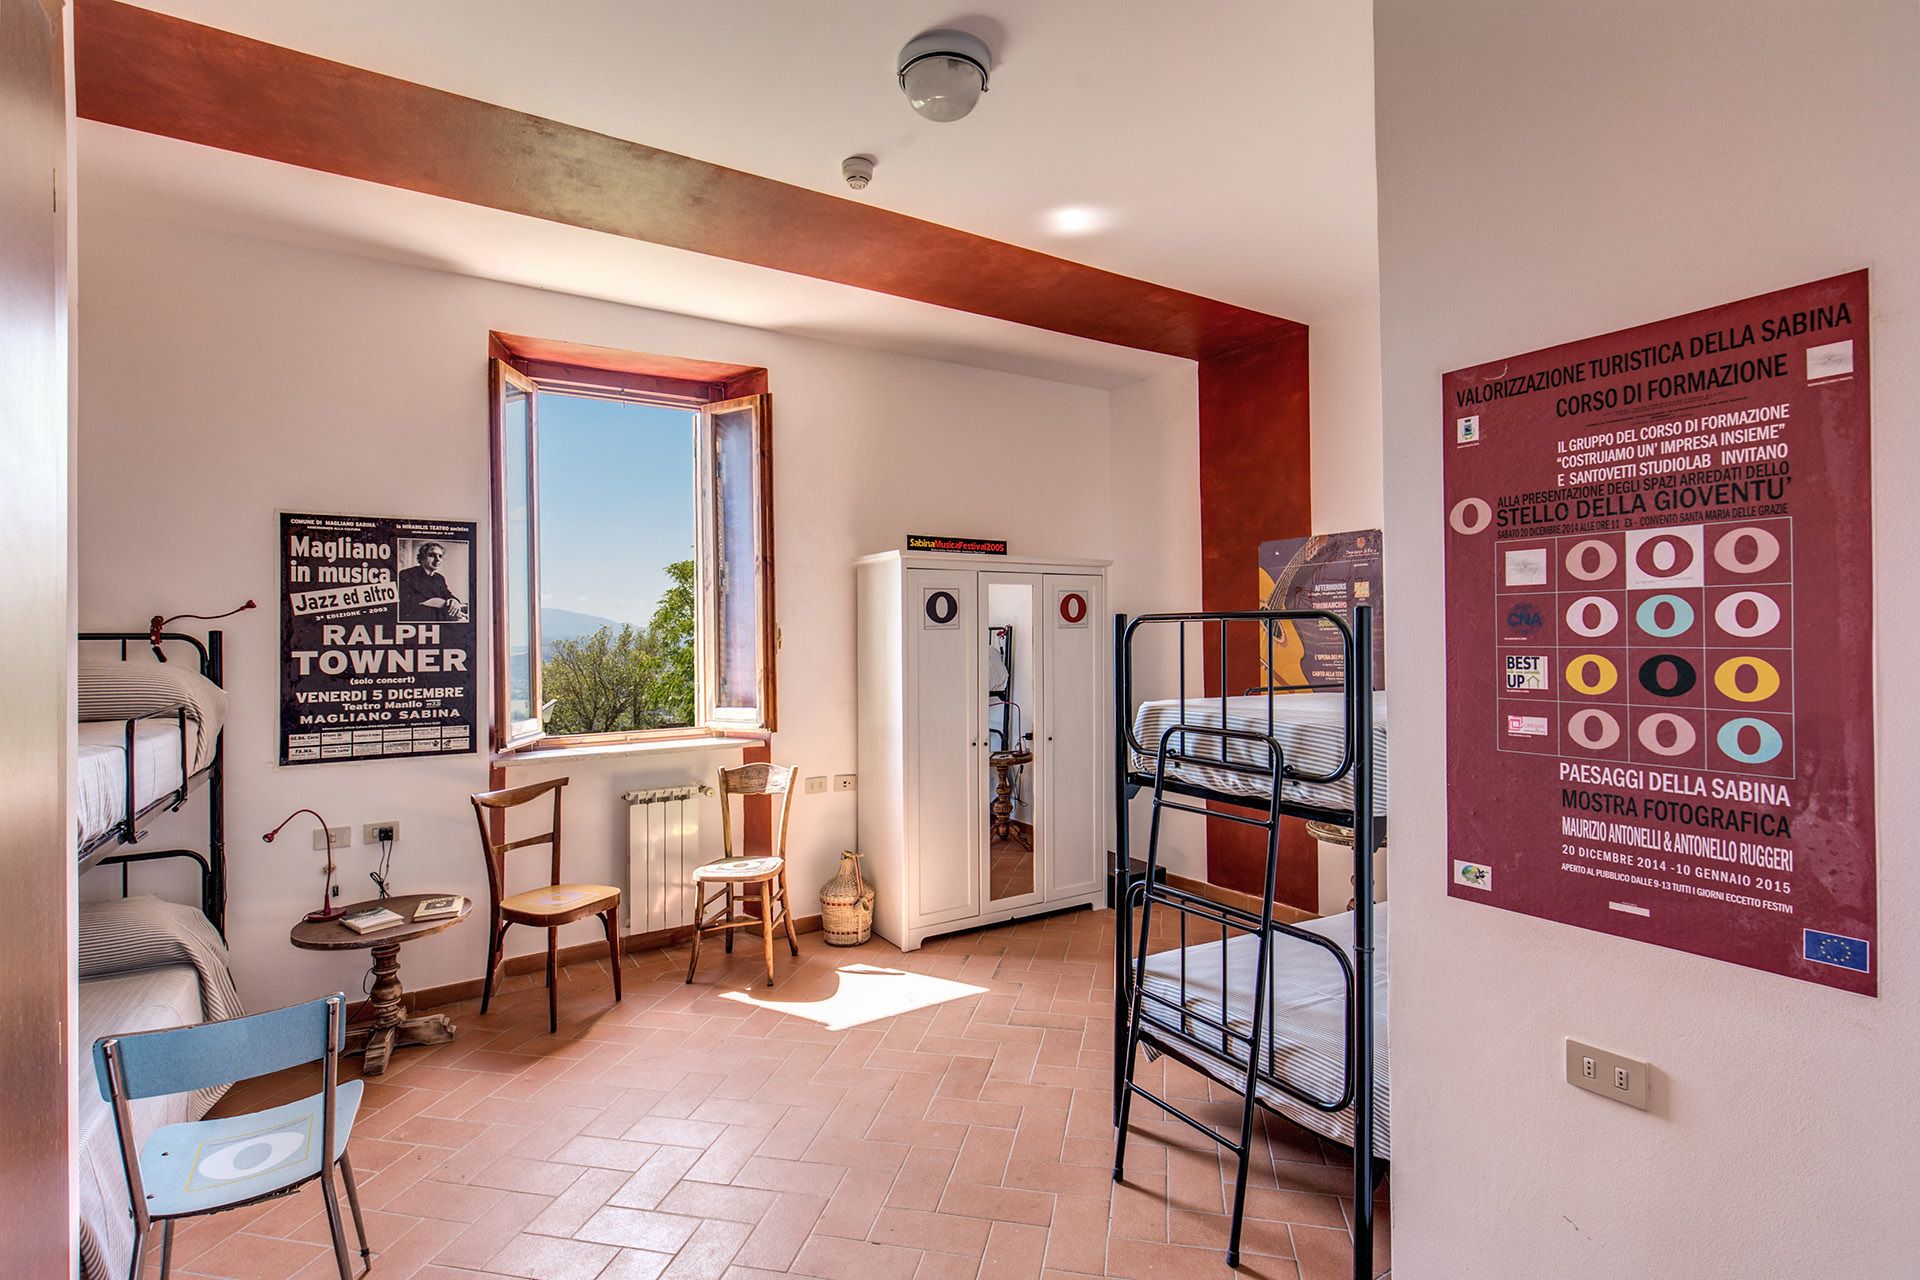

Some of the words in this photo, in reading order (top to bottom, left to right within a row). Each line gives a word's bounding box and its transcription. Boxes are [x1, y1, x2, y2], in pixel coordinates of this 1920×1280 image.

[1456, 362, 1586, 407] VALORIZZAZIONE
[1588, 341, 1684, 379] TURISTICA
[1690, 324, 1755, 358] DELLA
[1761, 302, 1853, 342] SABINA
[1555, 388, 1618, 417] CORSO
[1623, 383, 1641, 405] DI
[1649, 353, 1788, 400] FORMAZIONE
[1557, 441, 1568, 453] IL
[1568, 433, 1614, 451] GRUPPO
[1616, 428, 1638, 443] DEL
[1640, 422, 1682, 441] CORSO
[1684, 419, 1698, 433] DI
[1701, 403, 1790, 431] FORMAZIONE
[1661, 434, 1718, 454] IMPRESA
[1557, 473, 1565, 487] E
[1569, 464, 1636, 485] SANTOVETTI
[1639, 453, 1711, 476] STUDIOLAB
[1721, 443, 1788, 466] INVITANO
[1497, 495, 1520, 508] ALLA
[1522, 484, 1605, 505] PRESENTAZIONE
[1607, 481, 1640, 495] DEGLI
[1643, 476, 1677, 491] SPAZI
[1680, 466, 1742, 487] ARREDATI
[1745, 460, 1790, 479] DELLO
[1496, 502, 1569, 527] STELLO
[1576, 493, 1646, 519] DELLA
[1497, 528, 1519, 539] SABATO
[1520, 528, 1529, 538] 20
[1529, 525, 1561, 537] DICEMBRE
[1562, 523, 1578, 534] 2014
[1579, 521, 1596, 532] ALLE
[1596, 520, 1610, 530] ORE
[1611, 519, 1620, 529] 11
[1624, 518, 1633, 528] EX
[1640, 514, 1678, 527] CONVENTO
[1680, 511, 1704, 522] SANTA
[1705, 509, 1731, 521] MARIA
[1732, 506, 1756, 518] DELLE
[1758, 503, 1789, 516] GRAZIE
[290, 535, 391, 563] Magliano
[290, 560, 311, 583] in
[318, 561, 391, 584] musica
[295, 594, 339, 612] Jazz
[343, 588, 360, 605] ed
[363, 585, 395, 603] altro
[1314, 583, 1347, 592] AFTERHOURS
[326, 610, 361, 620] EDIZIONE
[1508, 612, 1543, 627] CNA
[322, 624, 440, 646] RALPH
[291, 648, 467, 676] TOWNER
[1507, 656, 1540, 670] BEST
[350, 677, 373, 685] (solo
[376, 676, 415, 684] concert)
[1508, 674, 1525, 688] UP
[296, 690, 367, 704] VENERDI
[372, 689, 383, 700] 5
[387, 686, 464, 700] DICEMBRE
[342, 702, 381, 711] Teatro
[384, 700, 423, 709] Manlio
[300, 711, 392, 725] MAGLIANO
[399, 708, 461, 720] SABINA
[1559, 762, 1644, 790] PAESAGGI
[1649, 771, 1707, 797] DELLA
[1711, 778, 1791, 807] SABINA
[1562, 789, 1638, 817] MOSTRA
[1644, 799, 1791, 839] FOTOGRAFICA
[1562, 816, 1607, 841] MAURIZIO
[1608, 823, 1661, 850] ANTONELLI
[1663, 831, 1672, 852] &
[1673, 833, 1738, 863] ANTONELLO
[1740, 842, 1793, 872] RUGGERI
[1562, 844, 1575, 856] 20
[1578, 847, 1634, 866] DICEMBRE
[1637, 856, 1667, 872] 2014
[1695, 866, 1751, 887] GENNAIO
[1755, 877, 1791, 894] 2015
[1561, 863, 1586, 875] APERTO
[1586, 867, 1596, 877] AL
[1596, 869, 1630, 883] PUBBLICO
[1631, 875, 1653, 887] DALLE
[1653, 879, 1671, 890] 9-13
[1672, 882, 1691, 895] TUTTI
[1696, 887, 1725, 901] GIORNI
[1726, 893, 1761, 908] ECCETTO
[1762, 901, 1793, 914] FESTIVI
